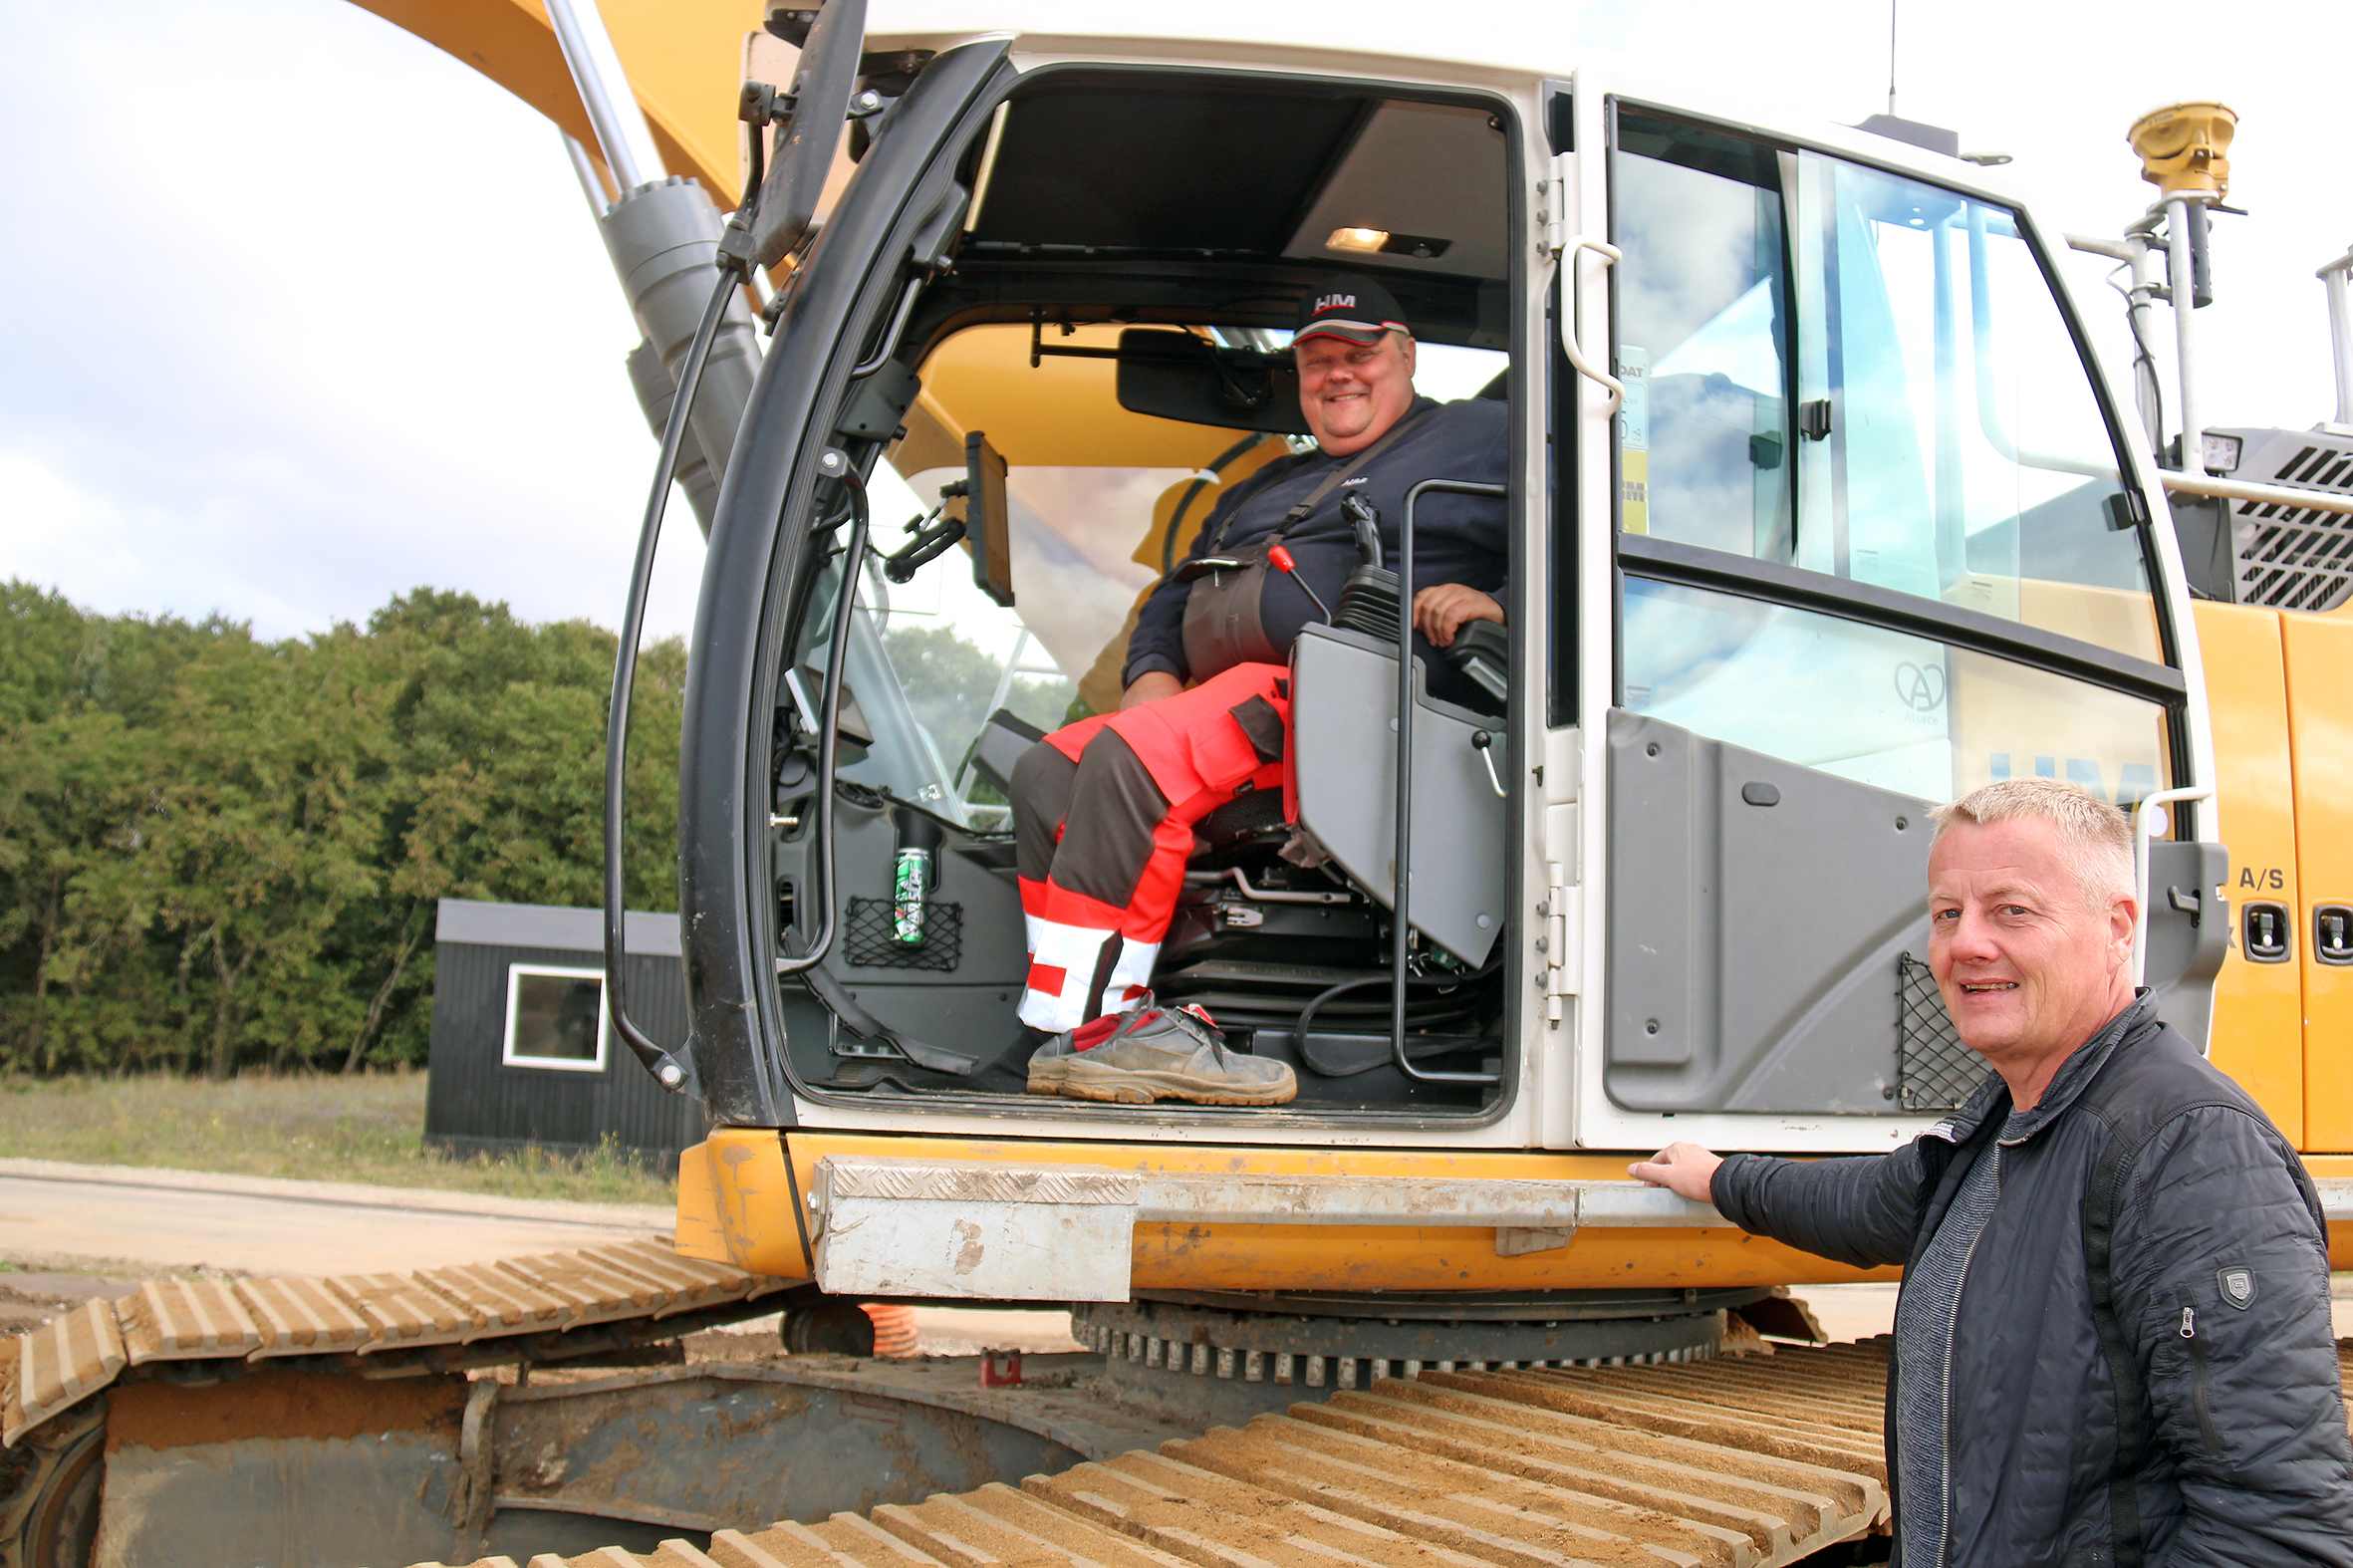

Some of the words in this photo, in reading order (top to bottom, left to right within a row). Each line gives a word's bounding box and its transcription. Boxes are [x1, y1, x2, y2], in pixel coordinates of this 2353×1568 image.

[1314, 293, 1356, 312] HM
[1904, 712, 1940, 725] Alsace
[2239, 867, 2284, 892] A/S
